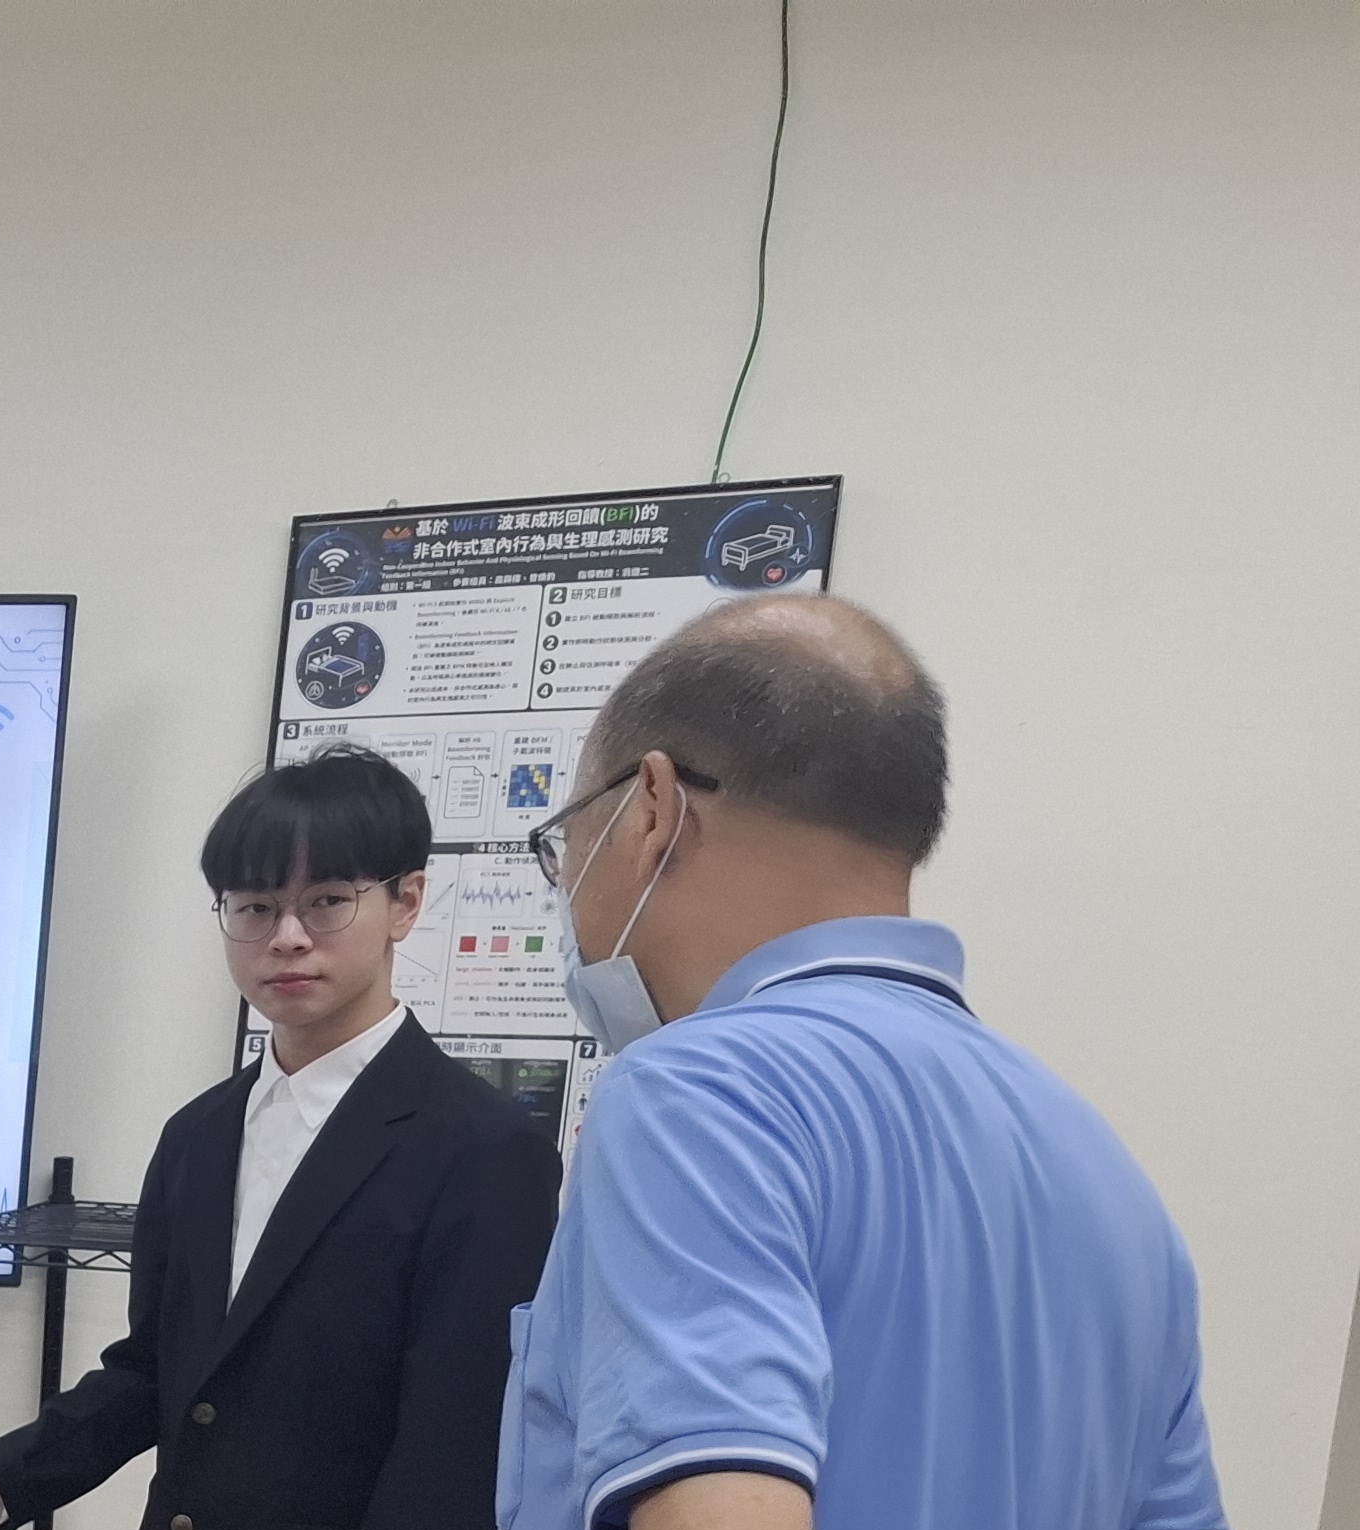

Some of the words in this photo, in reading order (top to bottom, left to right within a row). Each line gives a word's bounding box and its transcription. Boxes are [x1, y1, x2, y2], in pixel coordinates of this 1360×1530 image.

[415, 518, 449, 537] 基於
[412, 526, 669, 560] 非合作式室內行為與生理感測研究
[553, 589, 563, 602] 2
[286, 724, 296, 737] 3
